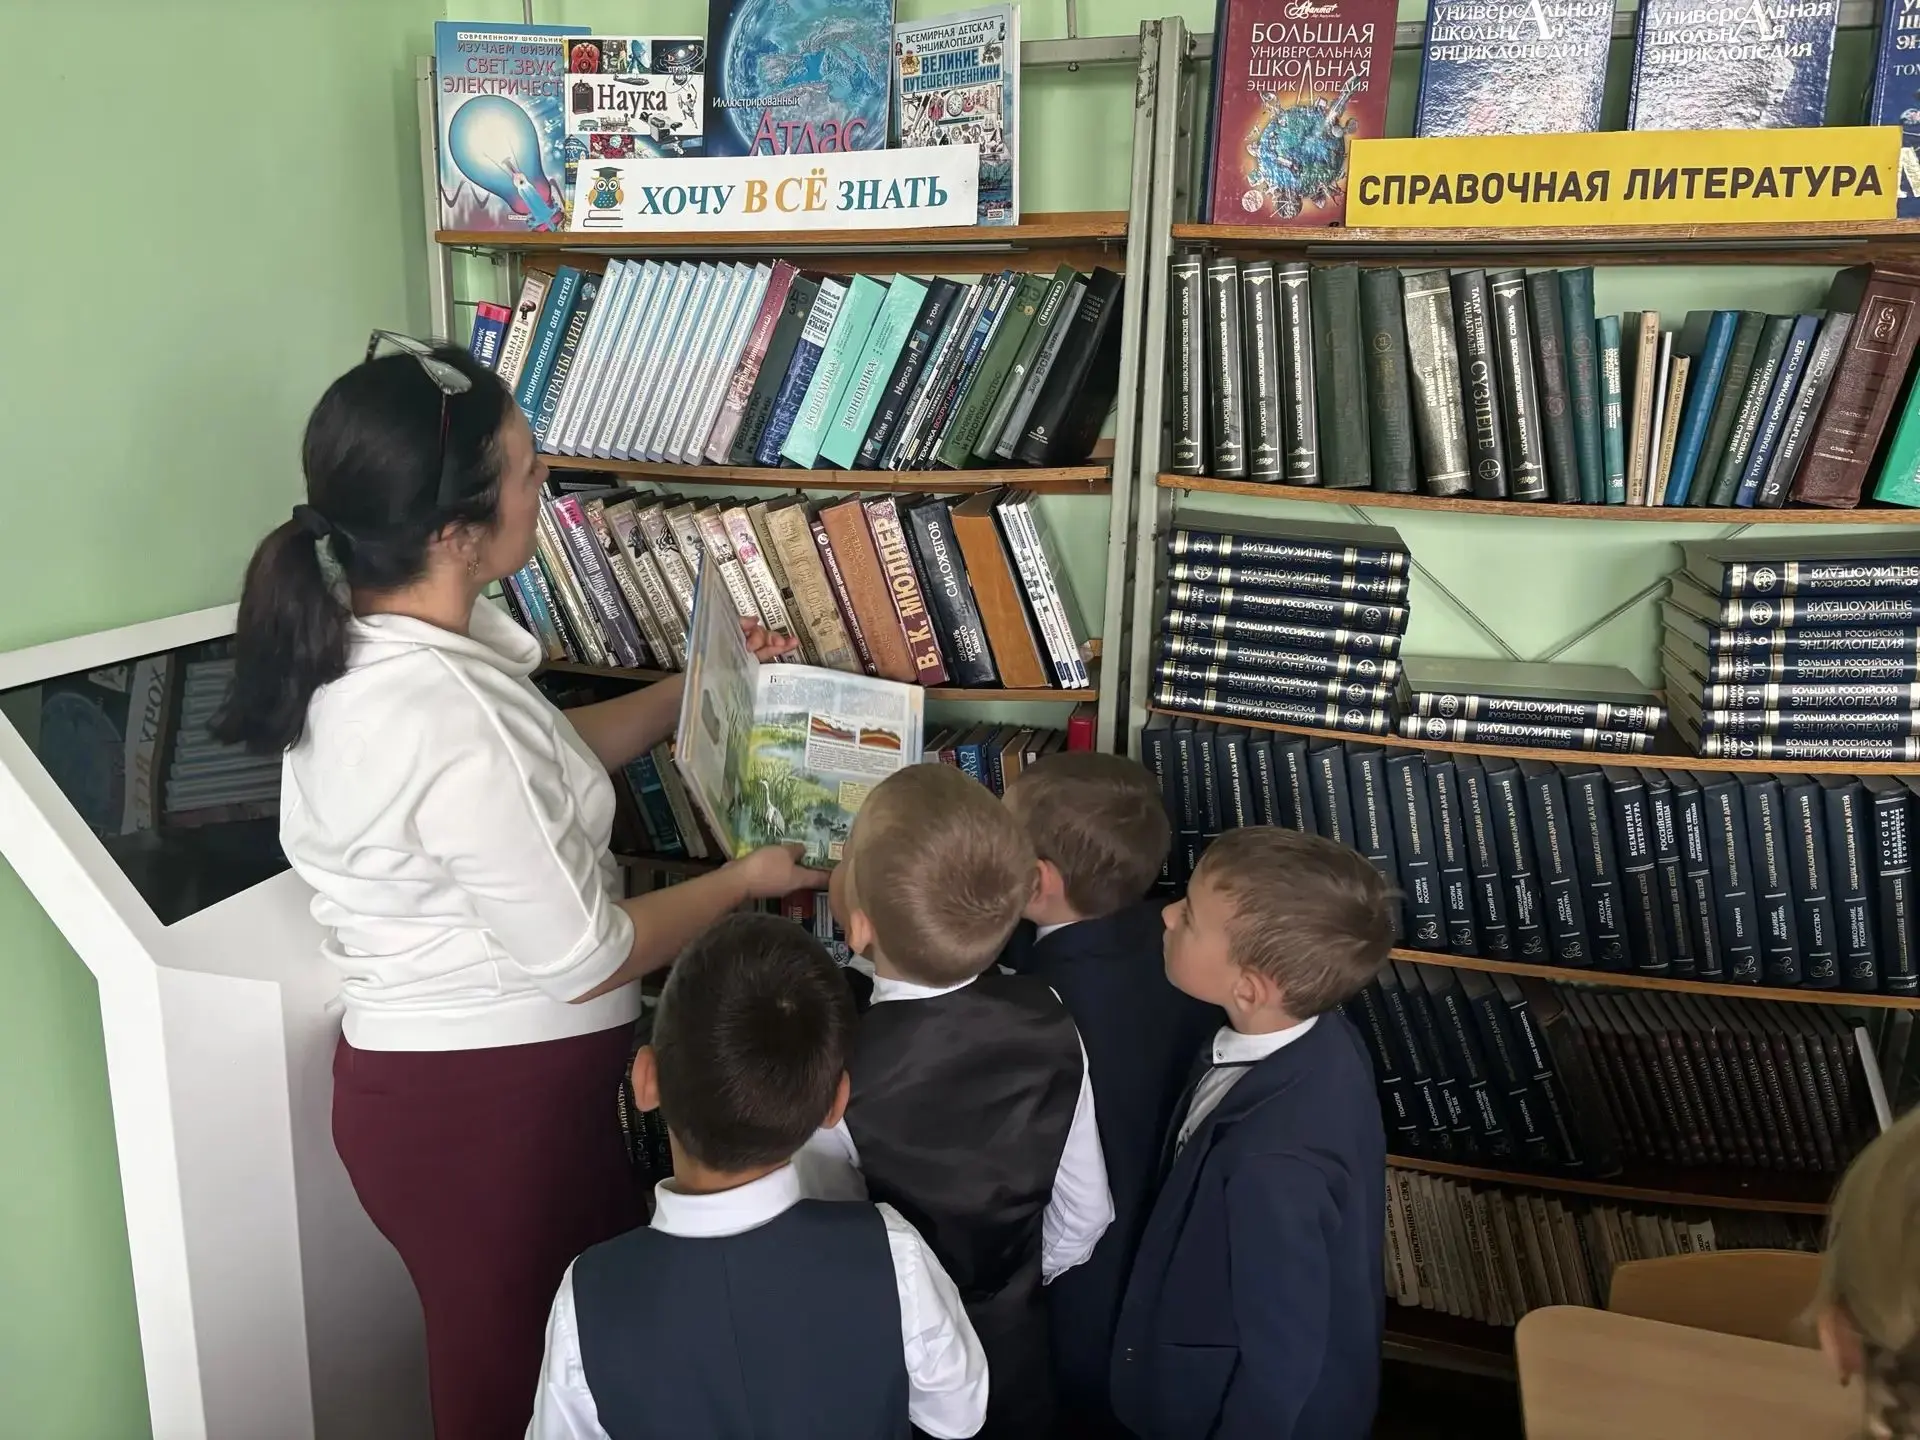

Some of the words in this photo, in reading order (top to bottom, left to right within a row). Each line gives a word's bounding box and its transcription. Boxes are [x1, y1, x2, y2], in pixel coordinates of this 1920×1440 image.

[906, 27, 955, 45] ВСЕМИРНАЯ
[958, 21, 995, 38] ДЕТСКАЯ
[916, 35, 985, 53] ЭНЦИКЛОПЕДИЯ
[1251, 23, 1375, 44] БОЛЬШАЯ
[457, 43, 515, 55] ИЗУЧАЕМ
[1250, 46, 1372, 59] УНИВЕРСАЛЬНАЯ
[921, 50, 980, 75] ВЕЛИКИЕ
[1249, 58, 1370, 78] ШКОЛЬНАЯ
[443, 76, 563, 97] ЭЛЕКТРИЧЕСТ
[902, 66, 1001, 92] ПУТЕШЕСТВЕННИКИ
[1247, 79, 1369, 92] ЭНЦИКЛОПЕДИЯ
[597, 84, 668, 118] Наука
[712, 96, 800, 109] Иллюстрированный
[750, 110, 868, 156] Атлас
[638, 184, 736, 216] ХОЧУ
[742, 168, 828, 214] ВСЁ
[836, 176, 948, 212] ЗНАТЬ
[1359, 170, 1610, 205] СПРАВОЧНАЯ
[1624, 165, 1882, 200] ЛИТЕРАТУРА
[1181, 286, 1189, 315] СЛОВАРЬ
[1219, 288, 1227, 319] СЛОВАРЬ
[1256, 291, 1264, 321] СЛОВАРЬ
[1292, 293, 1300, 324] СЛОВАРЬ
[1472, 286, 1482, 316] ТАТАР
[1508, 304, 1518, 335] СЛОВАРЬ
[482, 331, 497, 359] МИРА
[534, 411, 550, 442] ВСЕ
[543, 347, 569, 412] СТРАНЫ
[564, 310, 588, 352] МИРА
[1424, 366, 1437, 406] БОЛЬШОЙ
[1745, 358, 1777, 432] ТАТАРСКО-РУССКИЙ
[918, 430, 937, 461] ТЕХНИКА
[933, 397, 949, 430] ВОКРУГ
[946, 384, 957, 400] НАС
[1181, 394, 1189, 431] ТАТАРСКИЙ
[1223, 397, 1231, 434] ТАТАРСКИЙ
[1259, 400, 1268, 437] ТАТАРСКИЙ
[1296, 403, 1304, 440] ТАТАРСКИЙ
[1784, 411, 1804, 458] ШИГЪРИЯТ
[1801, 387, 1817, 412] ТЕЛЕ
[876, 422, 889, 444] Кем
[884, 409, 894, 422] ул
[1518, 416, 1529, 455] ТАТАРСКИЙ
[1734, 429, 1753, 465] СЛОВАРЬ
[1751, 455, 1763, 477] ТАТАР
[1768, 483, 1779, 496] 2
[570, 525, 600, 573] ШКОЛЬНИКА
[1242, 541, 1333, 559] ЭНЦИКЛОПЕДИЯ
[875, 517, 922, 616] МЮЛЛЕР
[1810, 566, 1920, 579] ЭНЦИКЛОПЕДИЯ
[1810, 579, 1872, 588] РОССИЙСКАЯ
[1874, 578, 1919, 587] БОЛЬШАЯ
[591, 571, 621, 620] СПРАВОЧНИК
[1205, 595, 1217, 604] 3
[1243, 594, 1281, 606] БОЛЬШАЯ
[1283, 598, 1333, 612] РОССИЙСКАЯ
[1806, 600, 1912, 612] ЭНЦИКЛОПЕДИЯ
[910, 619, 931, 643] К.
[1199, 622, 1209, 631] 4
[1235, 621, 1273, 632] БОЛЬШАЯ
[1274, 625, 1325, 639] РОССИЙСКАЯ
[1799, 630, 1842, 638] БОЛЬШАЯ
[1844, 629, 1904, 637] РОССИЙСКАЯ
[959, 625, 975, 662] РУССКОГО
[969, 628, 982, 653] ЯЗЫКА
[1200, 647, 1212, 656] 5
[1753, 636, 1768, 645] 9
[1798, 638, 1904, 650] ЭНЦИКЛОПЕДИЯ
[916, 645, 940, 671] В.
[1238, 646, 1275, 658] БОЛЬШАЯ
[1277, 651, 1328, 664] РОССИЙСКАЯ
[1798, 659, 1841, 667] БОЛЬШАЯ
[1843, 658, 1904, 667] РОССИЙСКАЯ
[1191, 671, 1202, 680] 6
[1228, 671, 1266, 682] БОЛЬШАЯ
[1266, 675, 1318, 688] РОССИЙСКАЯ
[1751, 661, 1767, 677] 12
[1797, 668, 1904, 679] ЭНЦИКЛОПЕДИЯ
[1190, 697, 1201, 706] 7
[1746, 689, 1760, 705] 18
[1791, 696, 1897, 707] ЭНЦИКЛОПЕДИЯ
[1792, 687, 1835, 695] БОЛЬШАЯ
[1838, 686, 1898, 694] РОССИЙСКАЯ
[1227, 696, 1264, 708] БОЛЬШАЯ
[1265, 700, 1316, 714] РОССИЙСКАЯ
[1489, 700, 1585, 716] ЭНЦИКЛОПЕДИЯ
[1613, 708, 1628, 725] 16
[1793, 713, 1836, 722] БОЛЬШАЯ
[1839, 713, 1899, 721] РОССИЙСКАЯ
[1477, 723, 1572, 739] ЭНЦИКЛОПЕДИЯ
[1792, 723, 1898, 734] ЭНЦИКЛОПЕДИЯ
[1600, 733, 1614, 749] 15
[1739, 740, 1753, 756] 20
[1785, 738, 1829, 747] БОЛЬШАЯ
[1831, 739, 1892, 747] РОССИЙСКАЯ
[1785, 749, 1892, 759] ЭНЦИКЛОПЕДИЯ
[1663, 804, 1674, 843] СТОЛИЦЫ
[1690, 802, 1699, 825] СТРАНЫ
[1624, 804, 1637, 856] ВСЕМИРНАЯ
[1633, 802, 1646, 855] ЛИТЕРАТУРА
[1655, 800, 1668, 851] РОССИЙСКИЕ
[1687, 832, 1696, 858] ИСТОРИЯ
[1880, 811, 1892, 866] РОССИЯ
[1422, 883, 1430, 904] РОССИИ
[1450, 884, 1458, 910] ИСТОРИЯ
[1456, 890, 1465, 911] РОССИИ
[1557, 898, 1565, 922] РУССКАЯ
[1776, 905, 1785, 921] МИРА
[1855, 906, 1864, 922] ЯЗЫК
[1735, 907, 1743, 937] ГЕОГРАФИЯ
[1772, 911, 1780, 938] ВЕЛИКИЕ
[1778, 921, 1787, 940] ЛЮДИ
[1814, 915, 1822, 946] ИСКУССТВО
[1857, 924, 1866, 947] РУССКИЙ
[1403, 1203, 1422, 1263] ИНОСТРАННЫХ
